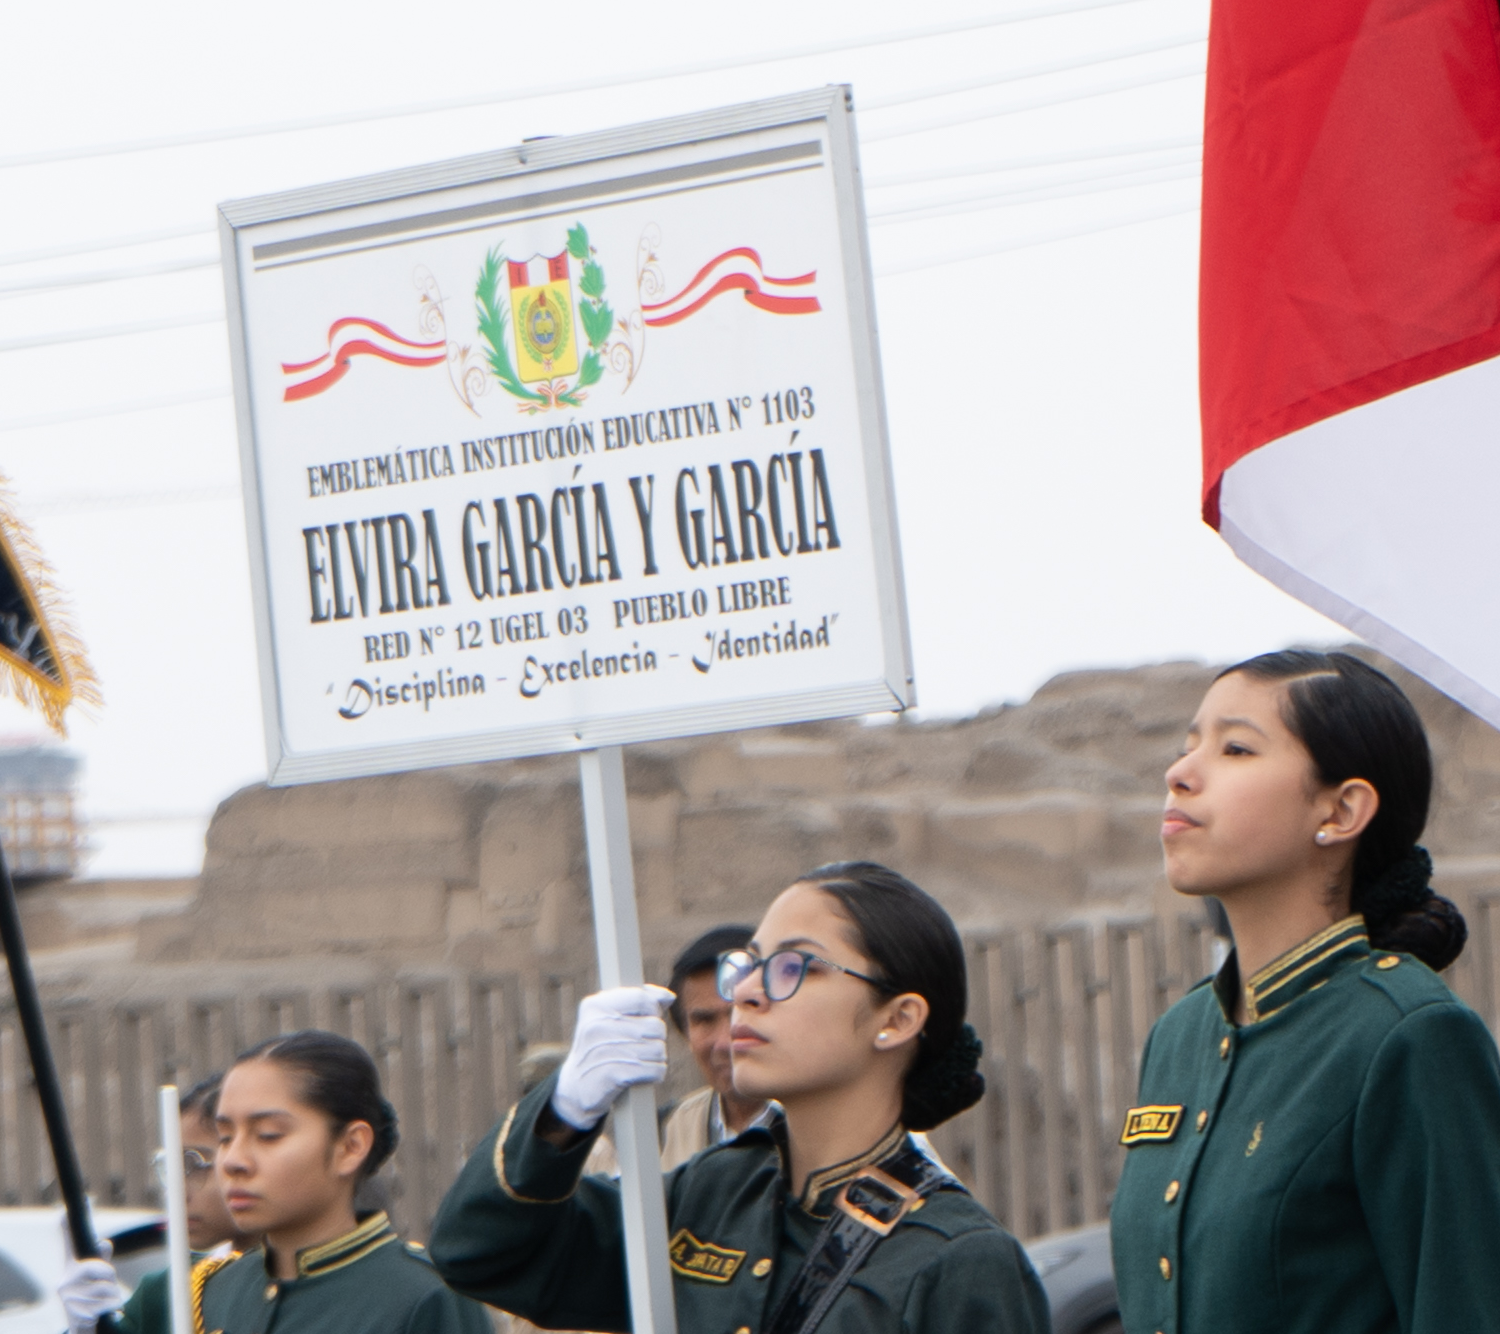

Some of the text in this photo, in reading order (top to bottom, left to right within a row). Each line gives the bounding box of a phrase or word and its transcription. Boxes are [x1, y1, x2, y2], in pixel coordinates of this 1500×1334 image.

[307, 386, 815, 498] EMBLEMÁTICA INSTITUCIÓN EDUCATIVA N° 1103
[302, 429, 841, 624] ELVIRA GARCÍA Y GARCÍA
[364, 576, 792, 663] RED N° 12 UGEL 03 PUEBLO LIBRE
[520, 640, 657, 699] Excelencia
